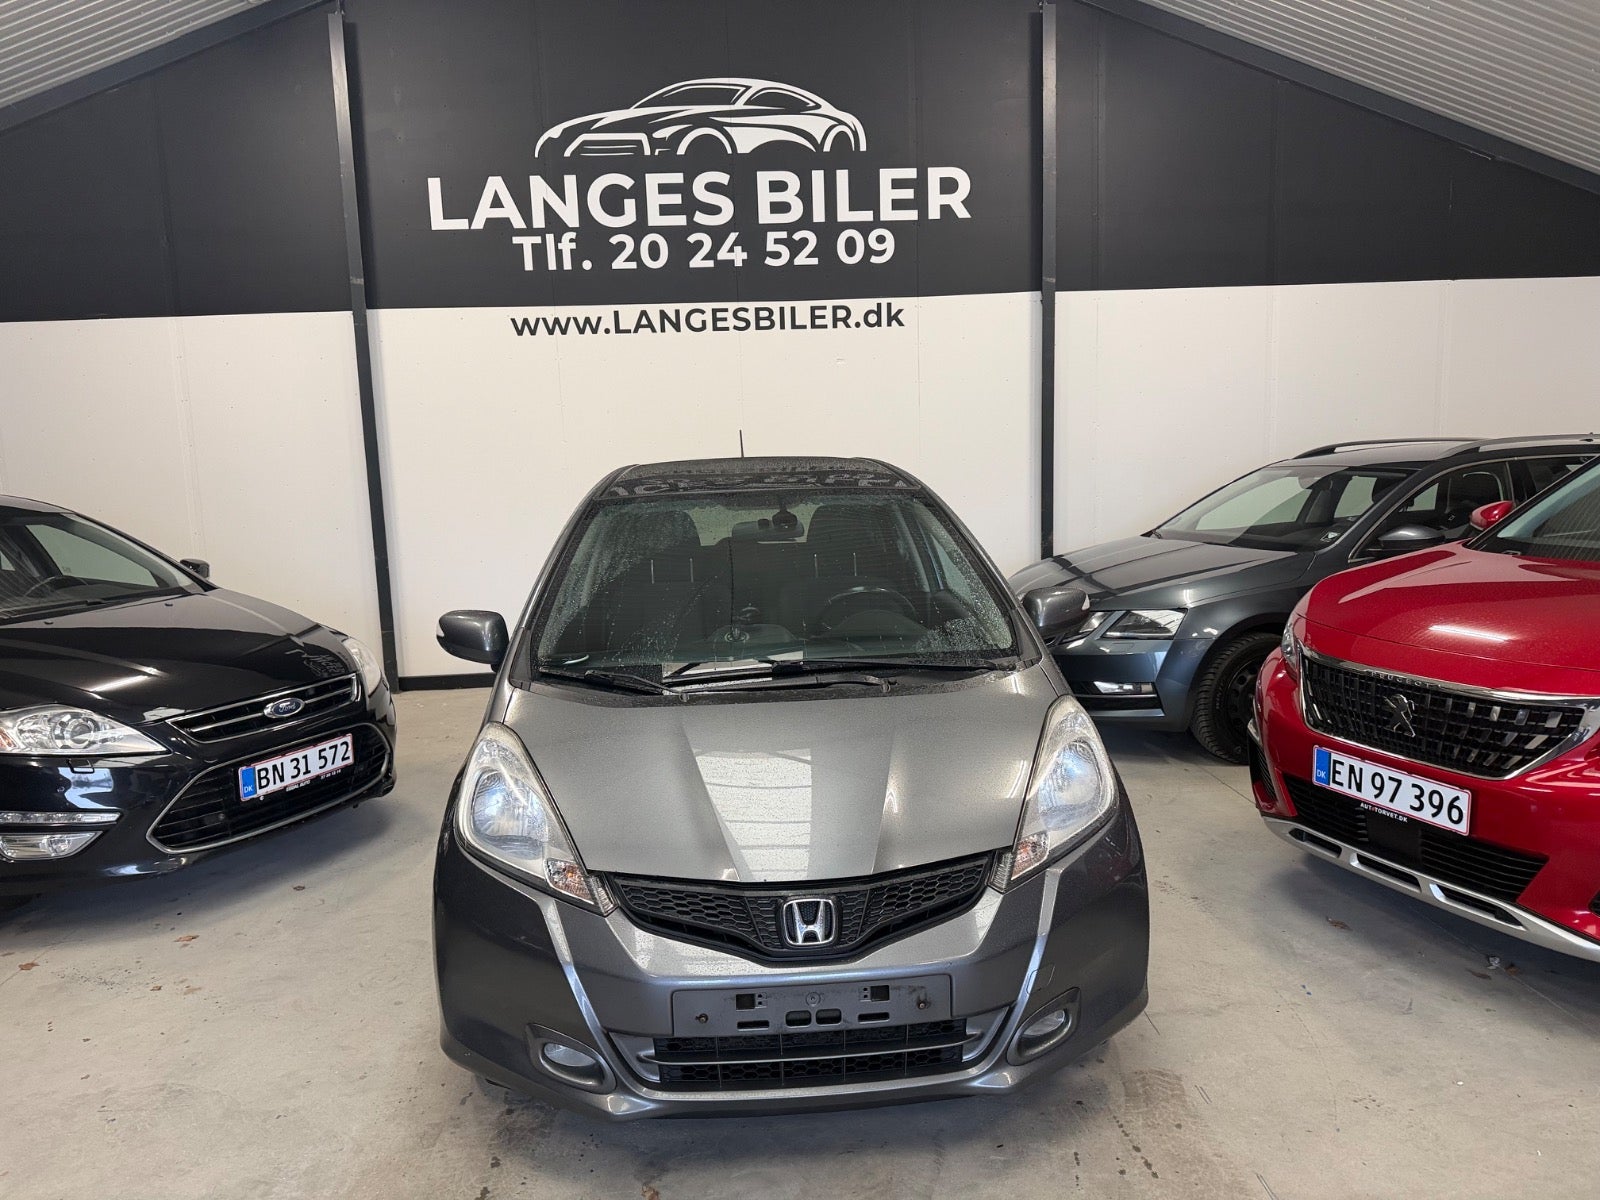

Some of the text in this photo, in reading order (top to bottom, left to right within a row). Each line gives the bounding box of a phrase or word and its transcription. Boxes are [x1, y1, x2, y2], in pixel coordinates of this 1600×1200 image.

[427, 166, 972, 231] LANGES BILER
[511, 227, 895, 272] Tlf. 20 24 52 09
[510, 302, 905, 337] www.LANGESBILER.dk
[257, 740, 351, 791] BN 31 572
[1316, 769, 1327, 780] DK
[243, 784, 253, 794] DK
[1331, 758, 1464, 825] EN 97 396
